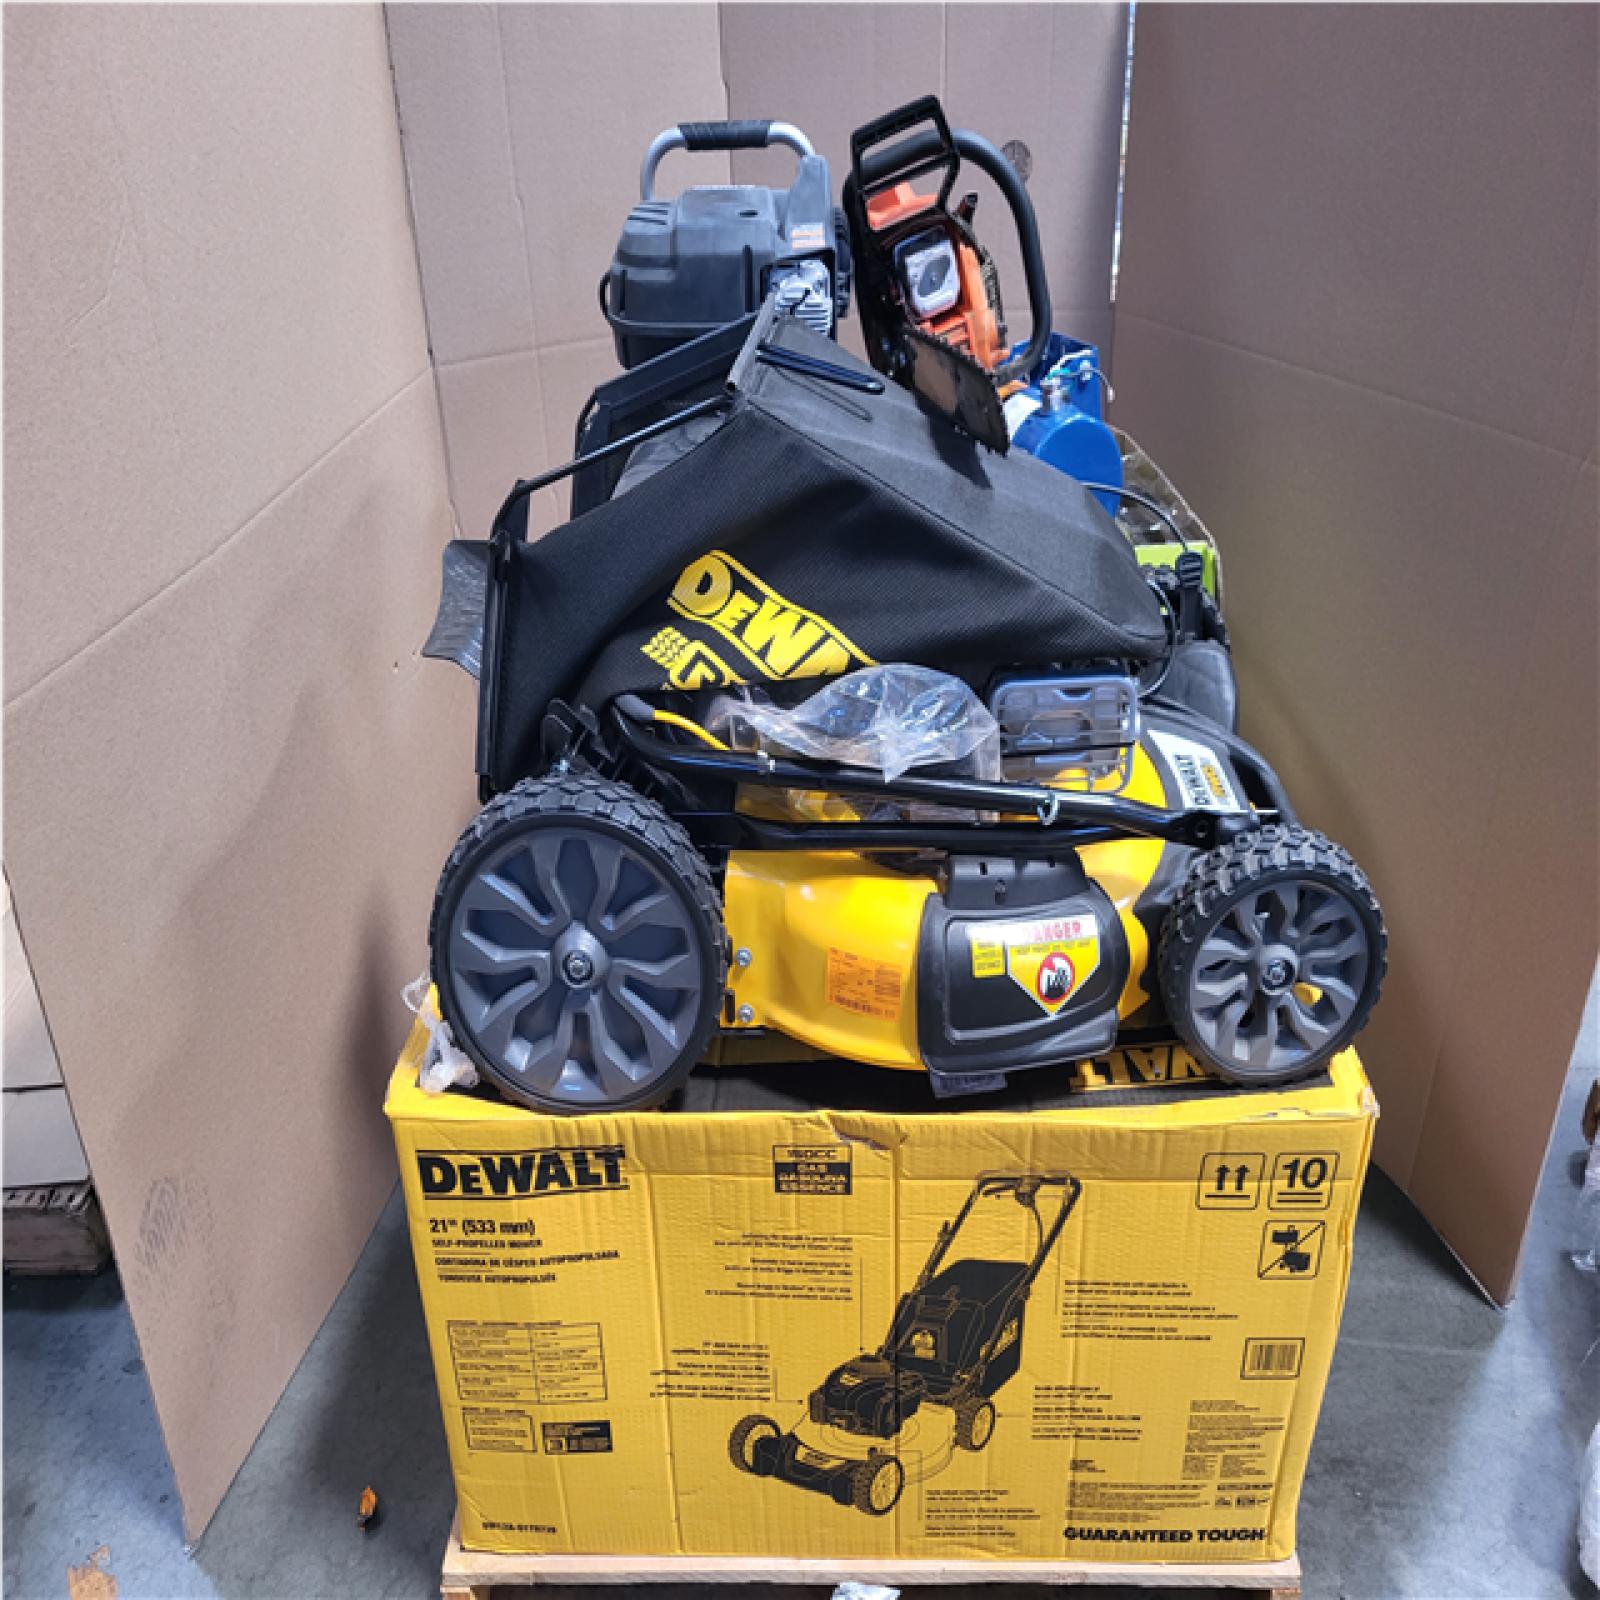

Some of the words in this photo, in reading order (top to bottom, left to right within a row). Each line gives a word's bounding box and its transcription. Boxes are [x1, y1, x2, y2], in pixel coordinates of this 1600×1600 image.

[416, 1150, 626, 1196] DEWALT
[1282, 1157, 1328, 1189] 10
[462, 1217, 495, 1236] (533
[1063, 1527, 1194, 1543] GUARANTEED
[1197, 1527, 1266, 1542] TOUGH
